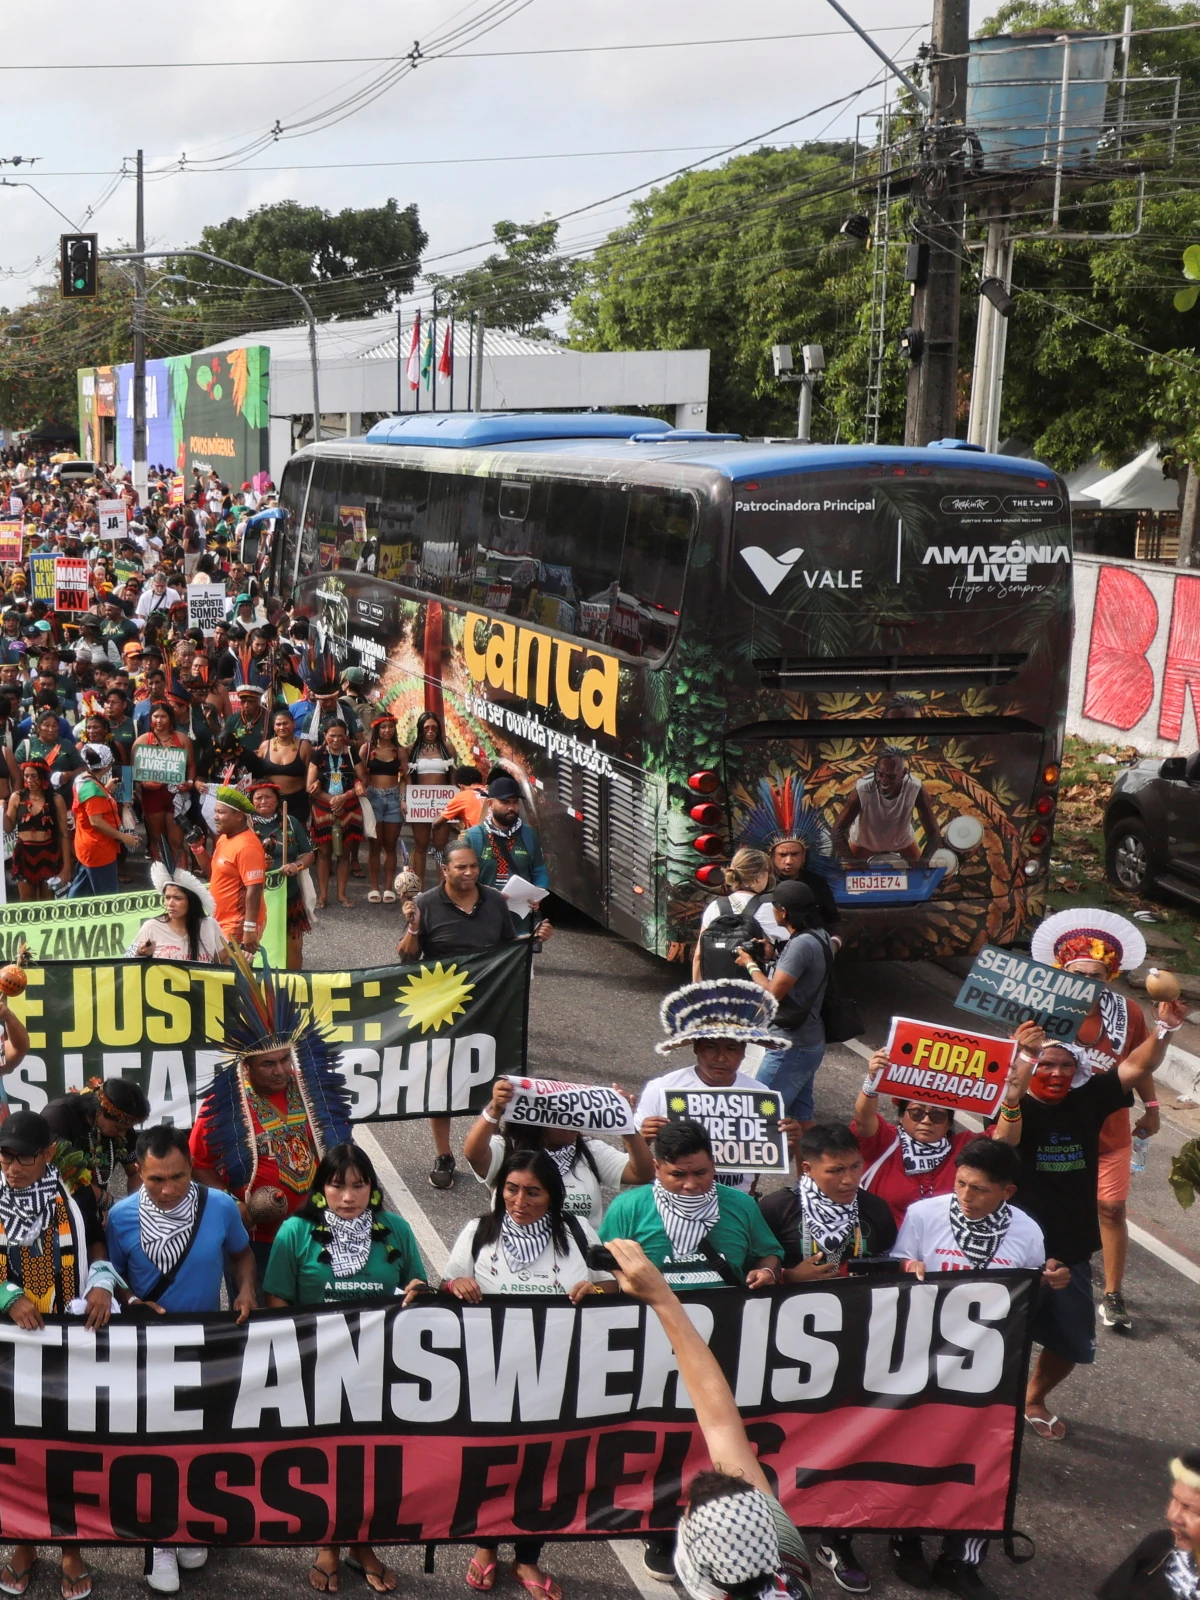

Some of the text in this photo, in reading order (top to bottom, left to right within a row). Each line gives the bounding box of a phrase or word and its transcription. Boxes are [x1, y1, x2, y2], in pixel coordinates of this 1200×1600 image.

[126, 375, 158, 419] AEIA
[735, 499, 875, 513] Patrocinadora Principal
[922, 539, 1071, 565] AMAZÔNIA
[33, 558, 56, 573] PARE
[57, 567, 87, 582] MAKE
[967, 563, 1027, 583] LIVE
[35, 573, 56, 586] DE NO
[56, 582, 87, 591] POLLUTERS
[803, 570, 863, 589] VALE
[34, 586, 56, 599] MATA
[948, 576, 1046, 603] Hoje Sempre
[58, 590, 84, 609] PAY
[190, 599, 224, 607] RESPOSTA
[190, 608, 224, 619] SOMOS
[361, 651, 376, 671] LIVE
[472, 692, 487, 719] vai
[487, 702, 504, 728] ser
[506, 710, 546, 748] ouvida
[548, 728, 569, 759] por
[135, 746, 186, 763] AMAZÔNIA
[139, 757, 180, 773] LIVRE DE
[420, 789, 455, 800] FUTURO
[410, 806, 445, 819] INDÍGE
[852, 877, 901, 889] HGJ1E74
[978, 948, 1097, 1004] SEM CLIMA
[62, 963, 382, 1045] JUSTCE:
[997, 979, 1055, 1014] PARA
[912, 1037, 988, 1079] FORA
[886, 1063, 999, 1103] MINERAÇÃO
[515, 1088, 621, 1113] A RESPOSTA
[686, 1093, 759, 1119] BRASIL
[512, 1105, 586, 1128] SOMOS
[739, 1118, 769, 1142] DE
[712, 1140, 777, 1165] ROLEO
[1037, 1153, 1067, 1161] SOMOS
[919, 1159, 926, 1170] A
[334, 1281, 384, 1290] RESPOSTA
[511, 1283, 567, 1294] RESPOSTA
[734, 1290, 842, 1407] IS
[863, 1280, 1012, 1397] US
[44, 1445, 423, 1544] FOSSIL
